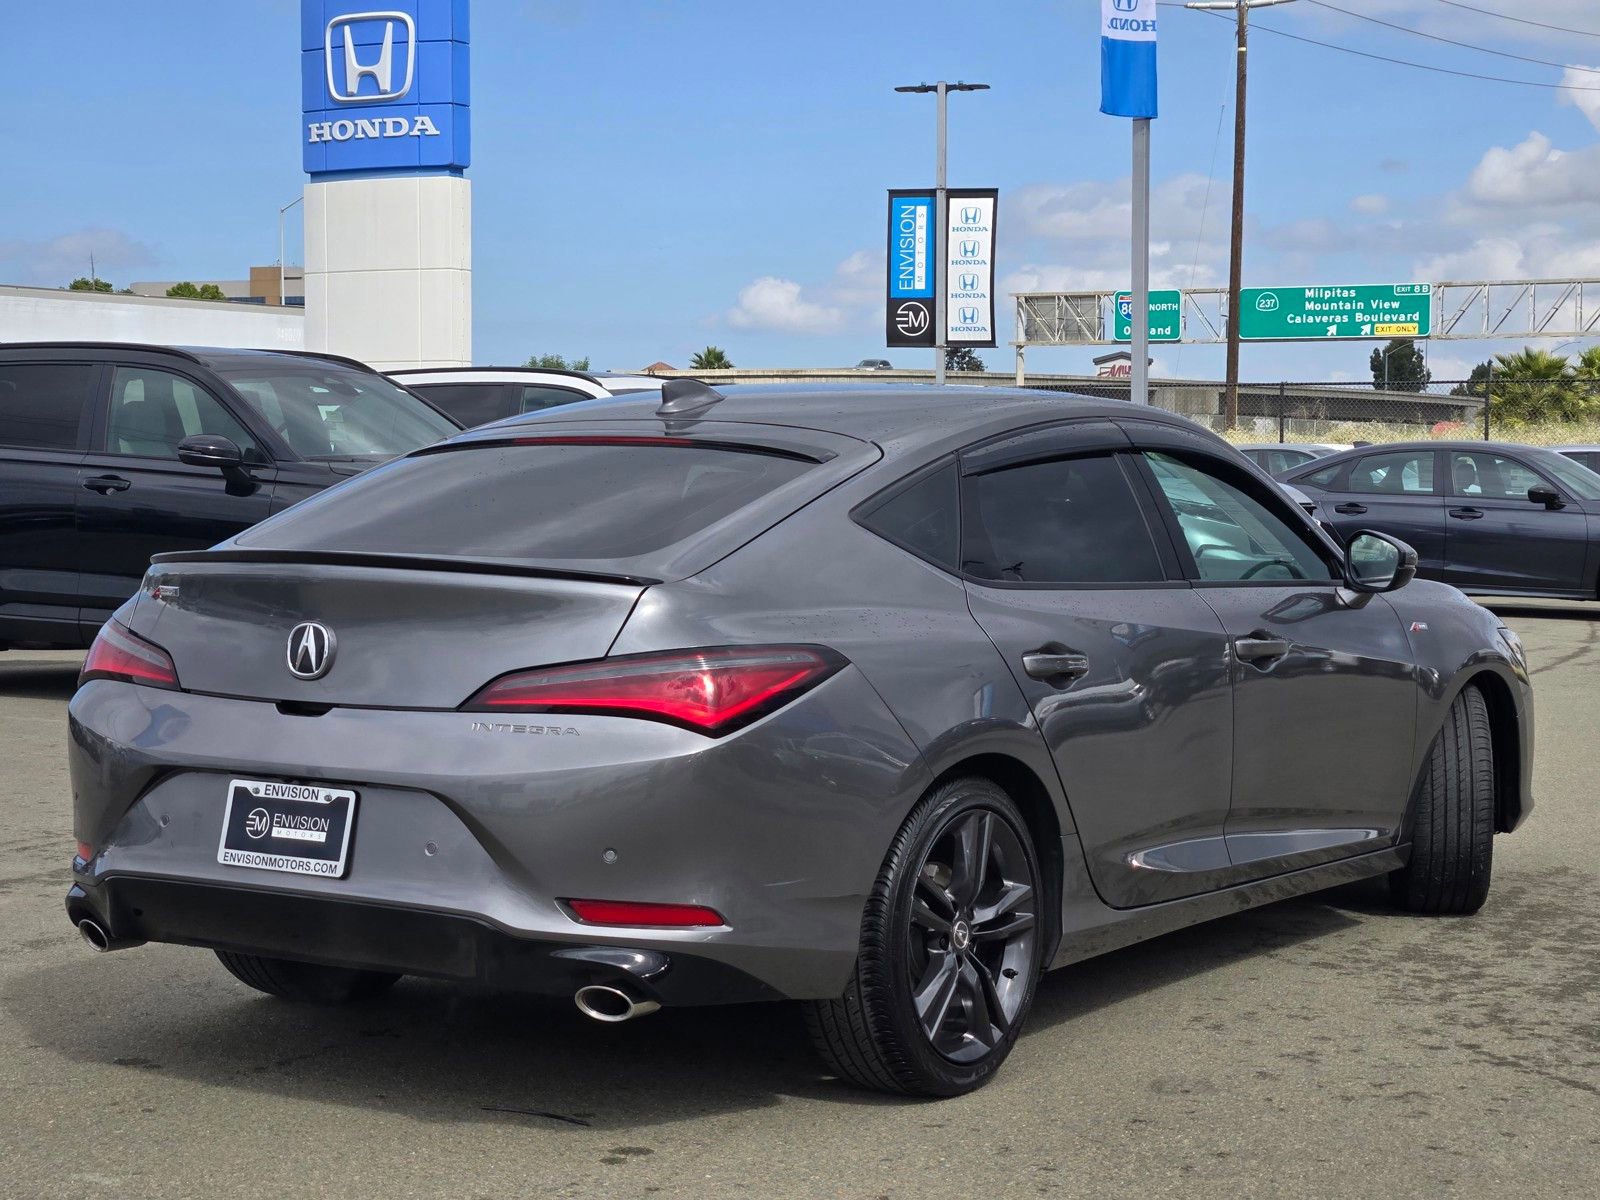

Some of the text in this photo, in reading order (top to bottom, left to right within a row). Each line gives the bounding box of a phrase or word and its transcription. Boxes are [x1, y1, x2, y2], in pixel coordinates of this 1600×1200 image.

[308, 116, 440, 143] HONDA
[899, 205, 915, 290] ENVISION
[917, 213, 925, 282] MOTORS
[1304, 288, 1356, 299] Milpitas
[1149, 303, 1178, 311] NORTH
[1258, 299, 1275, 308] 237
[1304, 299, 1400, 311] Mountain View
[1286, 312, 1420, 324] Calaveras Boulevard
[1123, 326, 1171, 335] Oand
[471, 722, 580, 736] INTEGRA
[264, 784, 320, 801] ENVISION
[273, 813, 330, 832] ENVISION
[276, 829, 322, 840] MOTORS
[223, 851, 338, 875] ENVISIONMOTORS.COM
